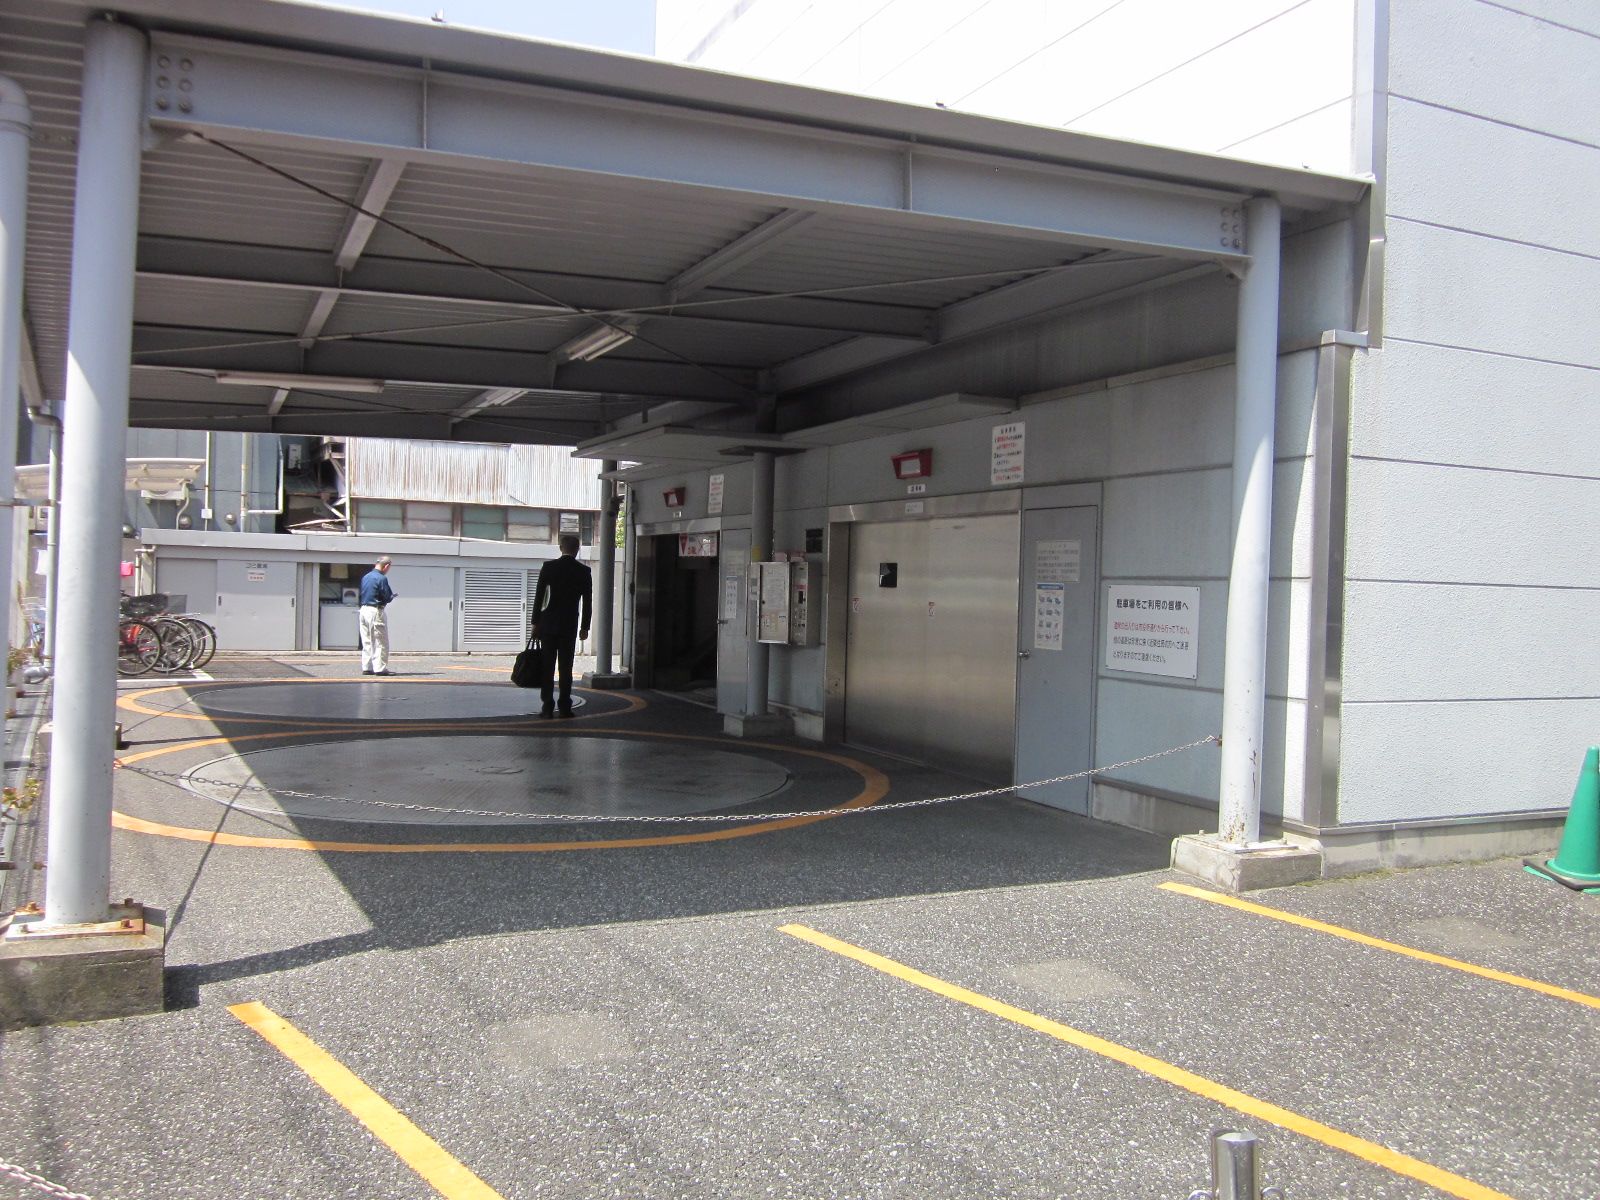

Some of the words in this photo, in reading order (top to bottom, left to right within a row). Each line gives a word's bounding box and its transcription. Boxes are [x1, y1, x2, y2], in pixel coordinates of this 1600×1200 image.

[1116, 598, 1189, 611] 駐車場をご利用の皆様へ
